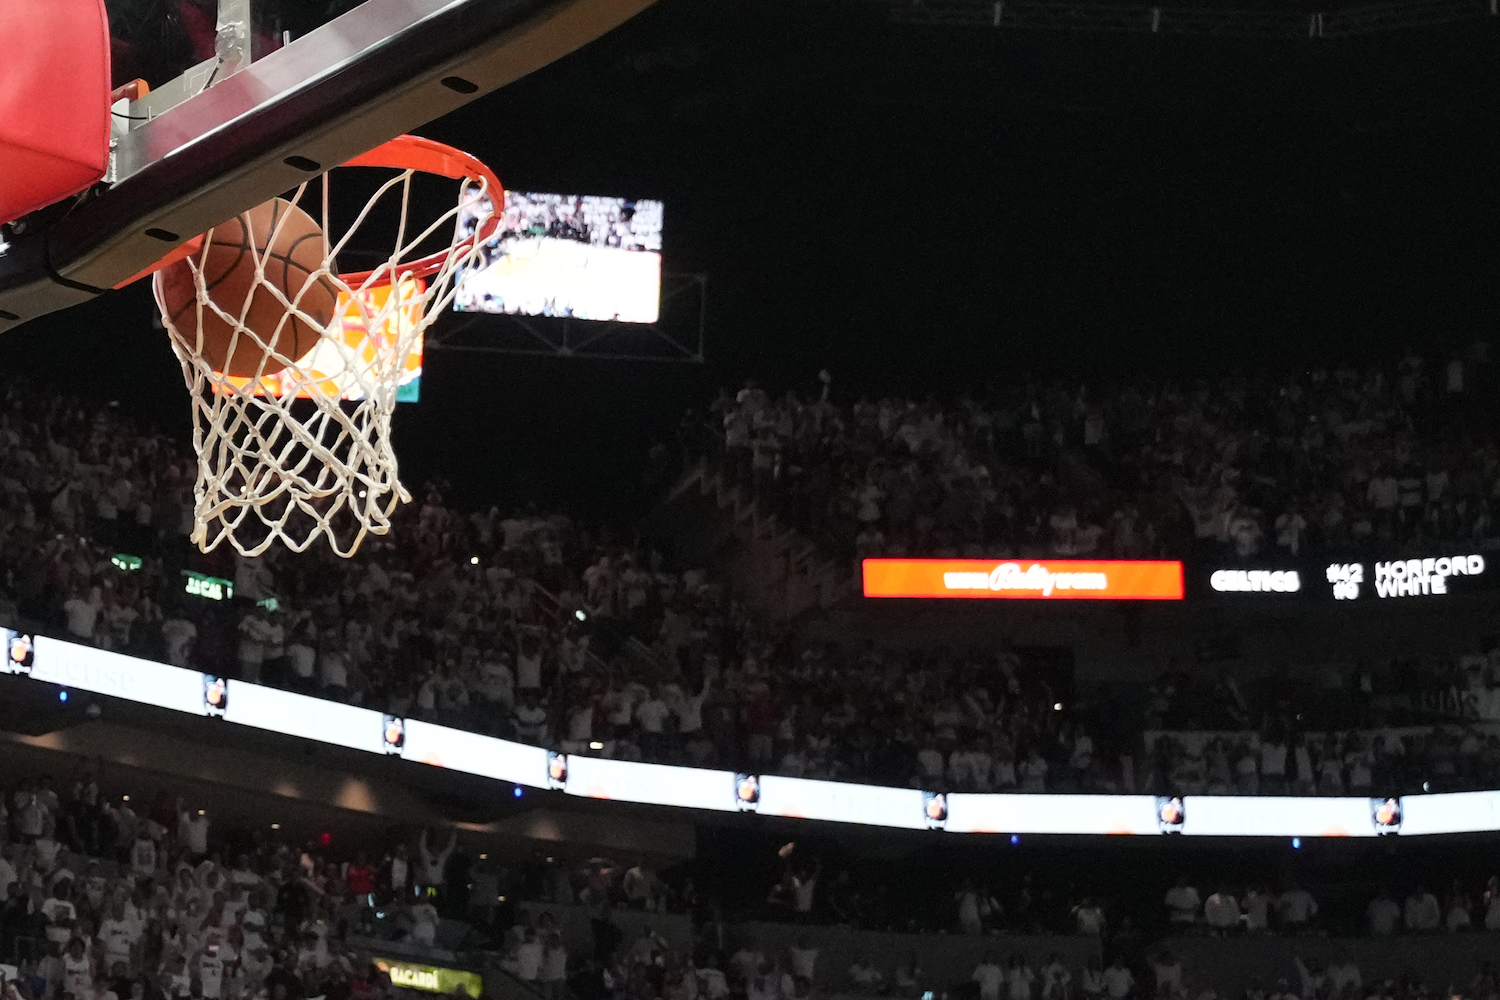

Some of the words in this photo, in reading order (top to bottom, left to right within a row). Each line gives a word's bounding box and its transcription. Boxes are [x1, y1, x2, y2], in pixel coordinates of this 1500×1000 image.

[1375, 554, 1485, 580] HORFORD
[1210, 569, 1300, 593] CELTICS
[1375, 576, 1448, 599] WHITE
